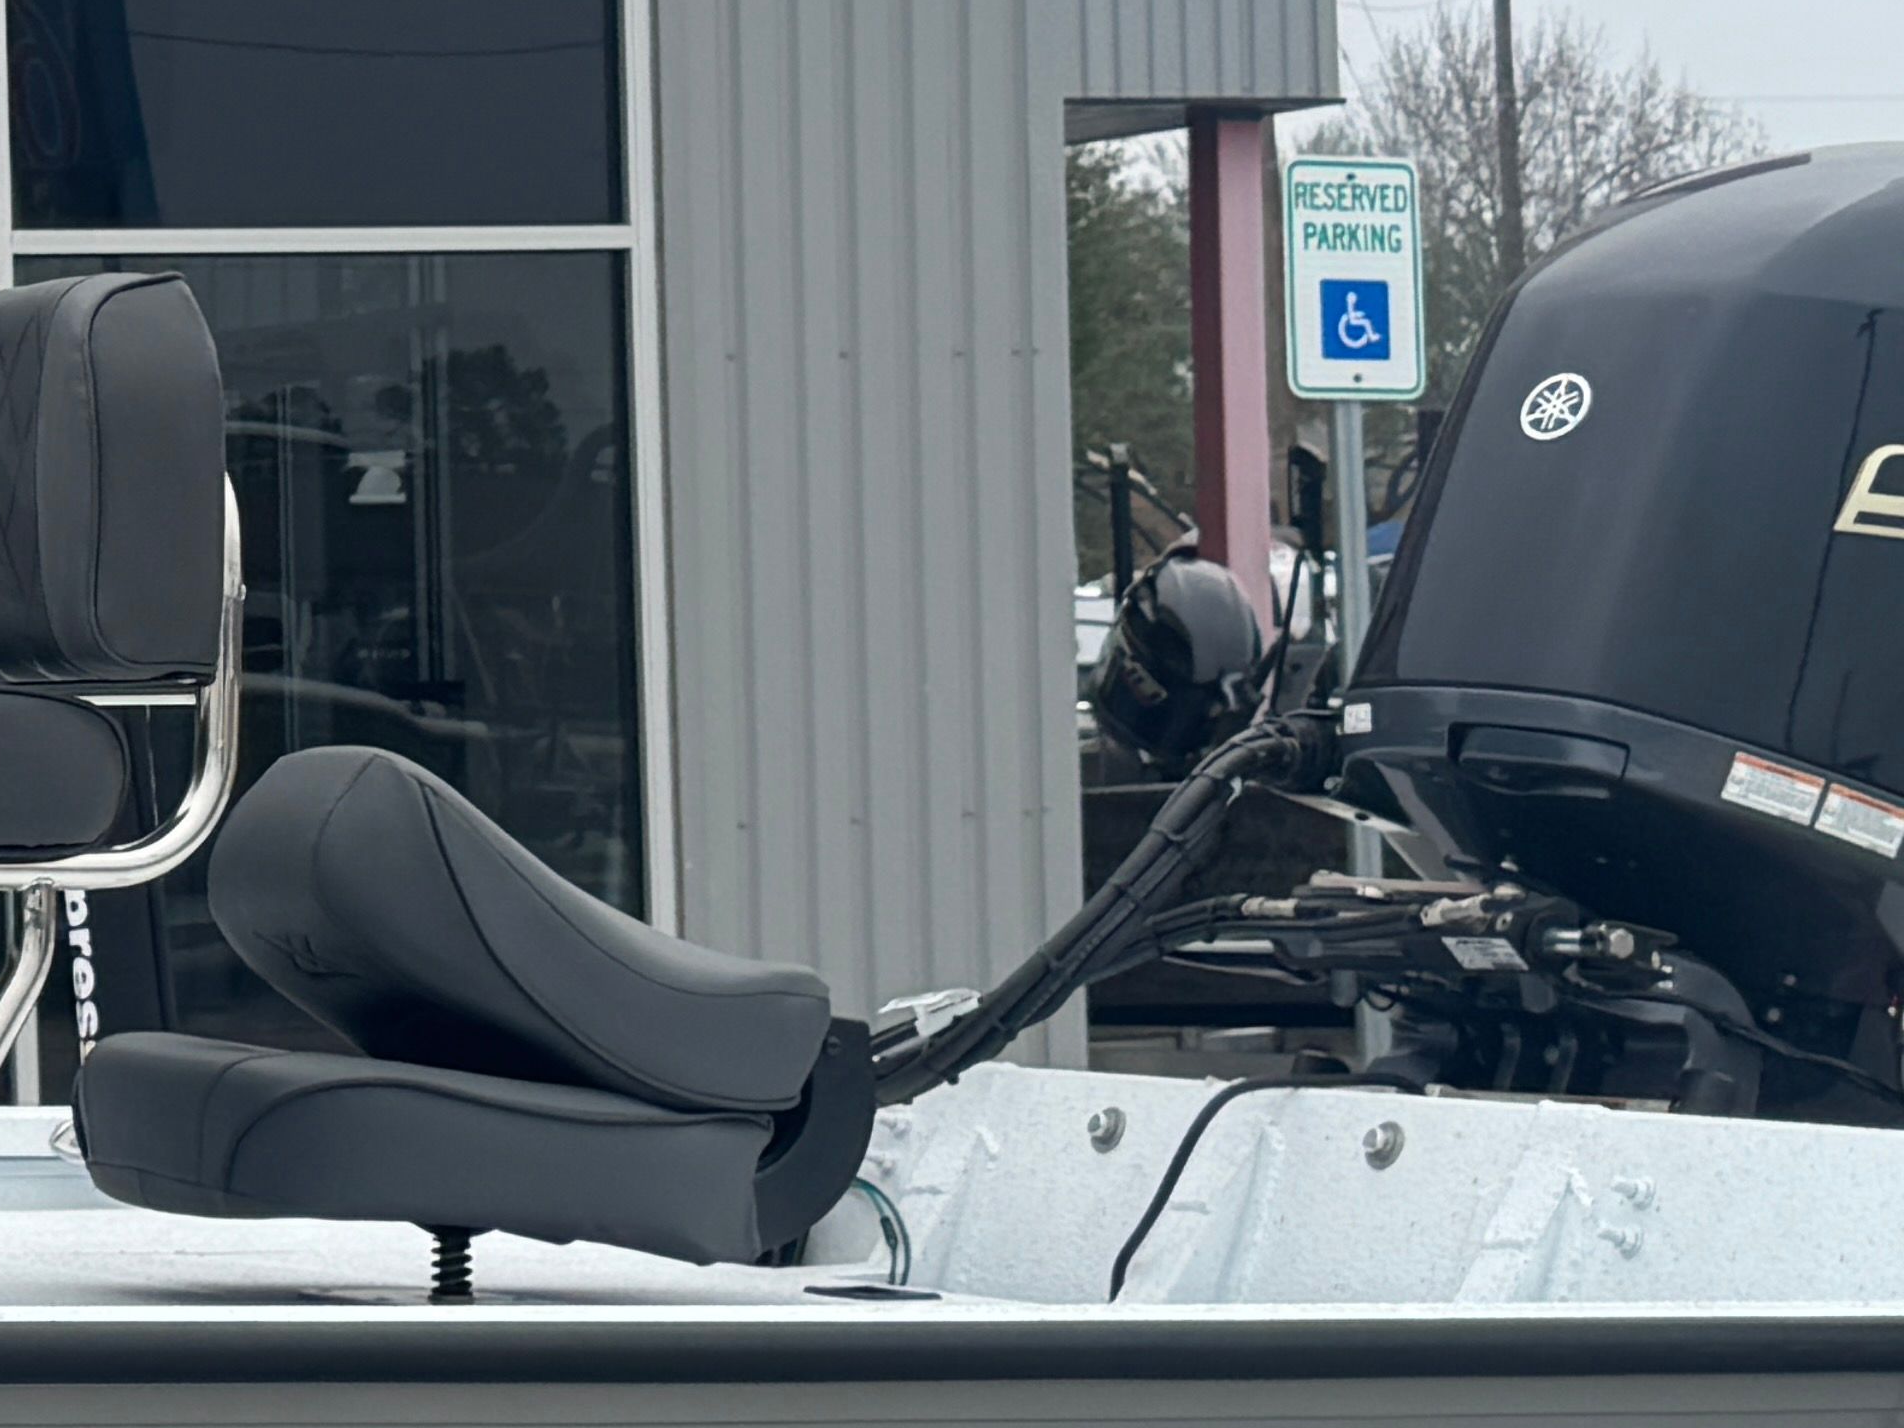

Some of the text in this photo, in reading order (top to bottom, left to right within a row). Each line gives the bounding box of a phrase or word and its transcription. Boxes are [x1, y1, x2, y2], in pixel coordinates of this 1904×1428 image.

[1294, 181, 1408, 213] RESERVED
[1303, 221, 1403, 254] PARKING
[64, 889, 100, 1068] pres
